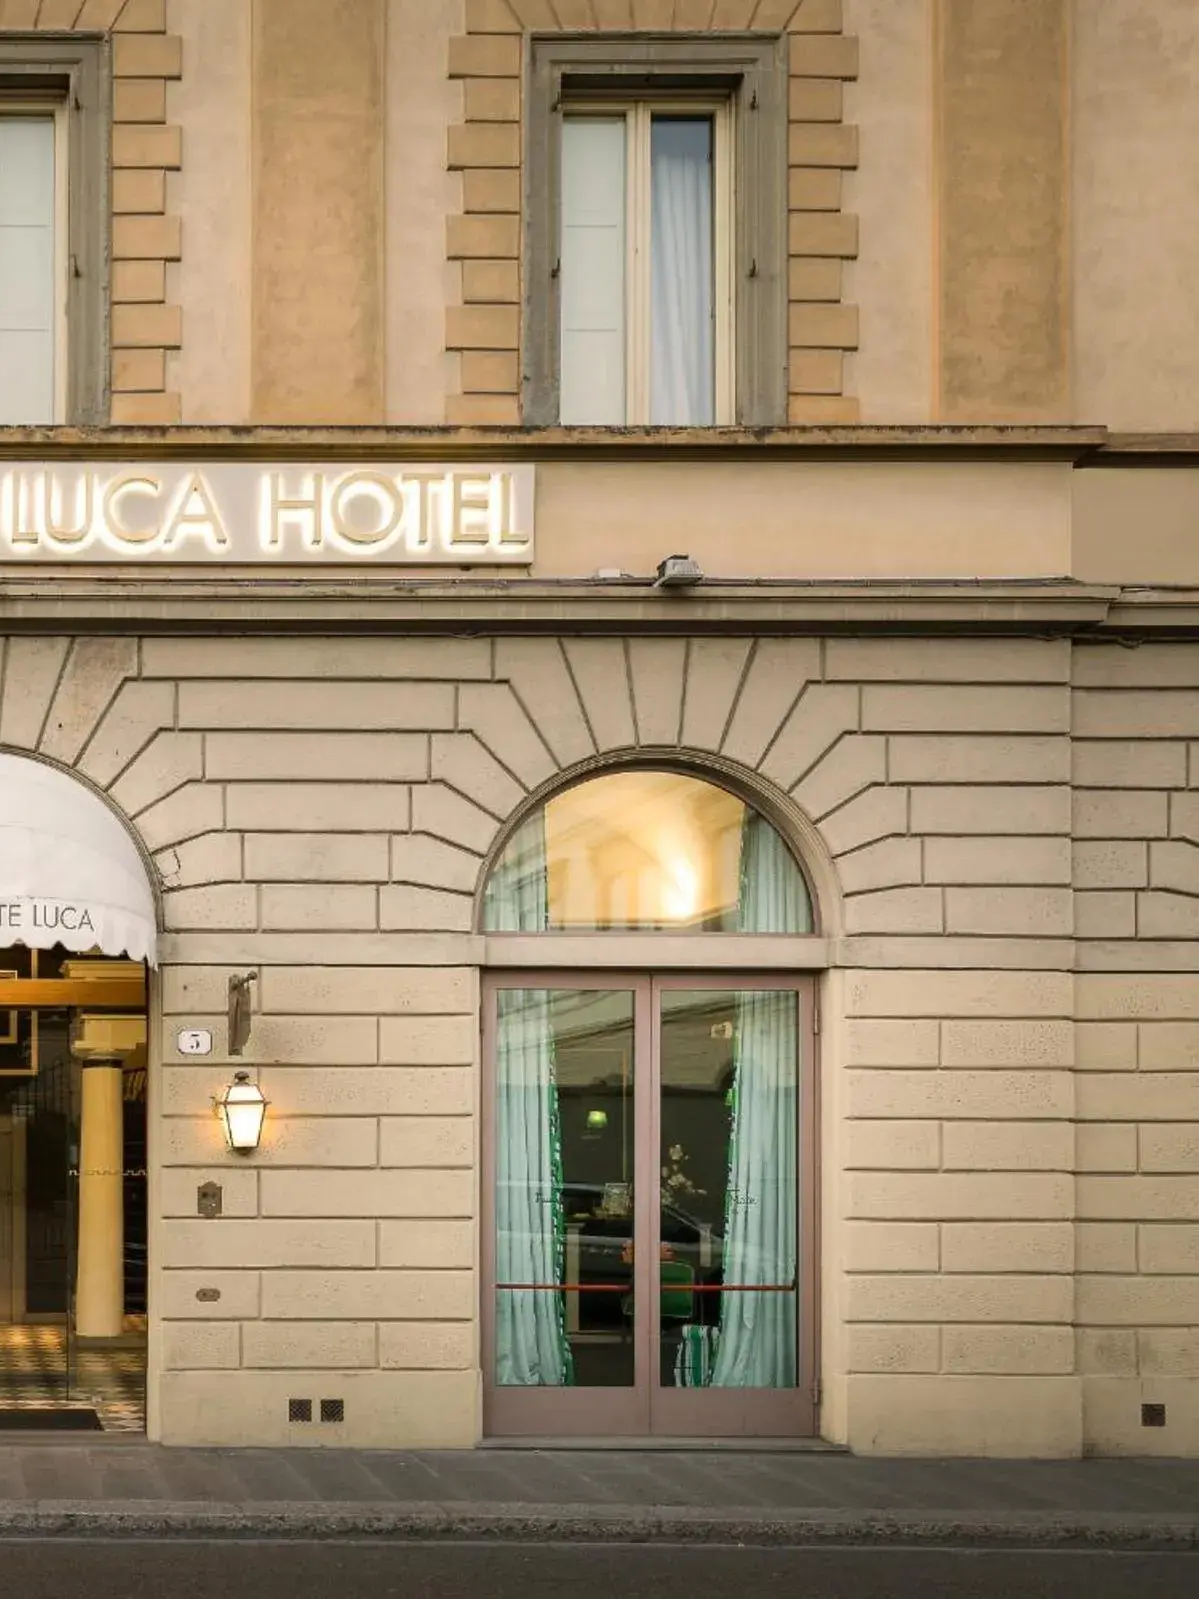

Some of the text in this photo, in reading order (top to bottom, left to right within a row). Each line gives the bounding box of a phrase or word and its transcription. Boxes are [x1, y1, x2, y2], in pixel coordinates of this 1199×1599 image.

[9, 468, 229, 545] LUCA
[267, 469, 532, 546] HOTEL
[32, 903, 95, 932] LUCA
